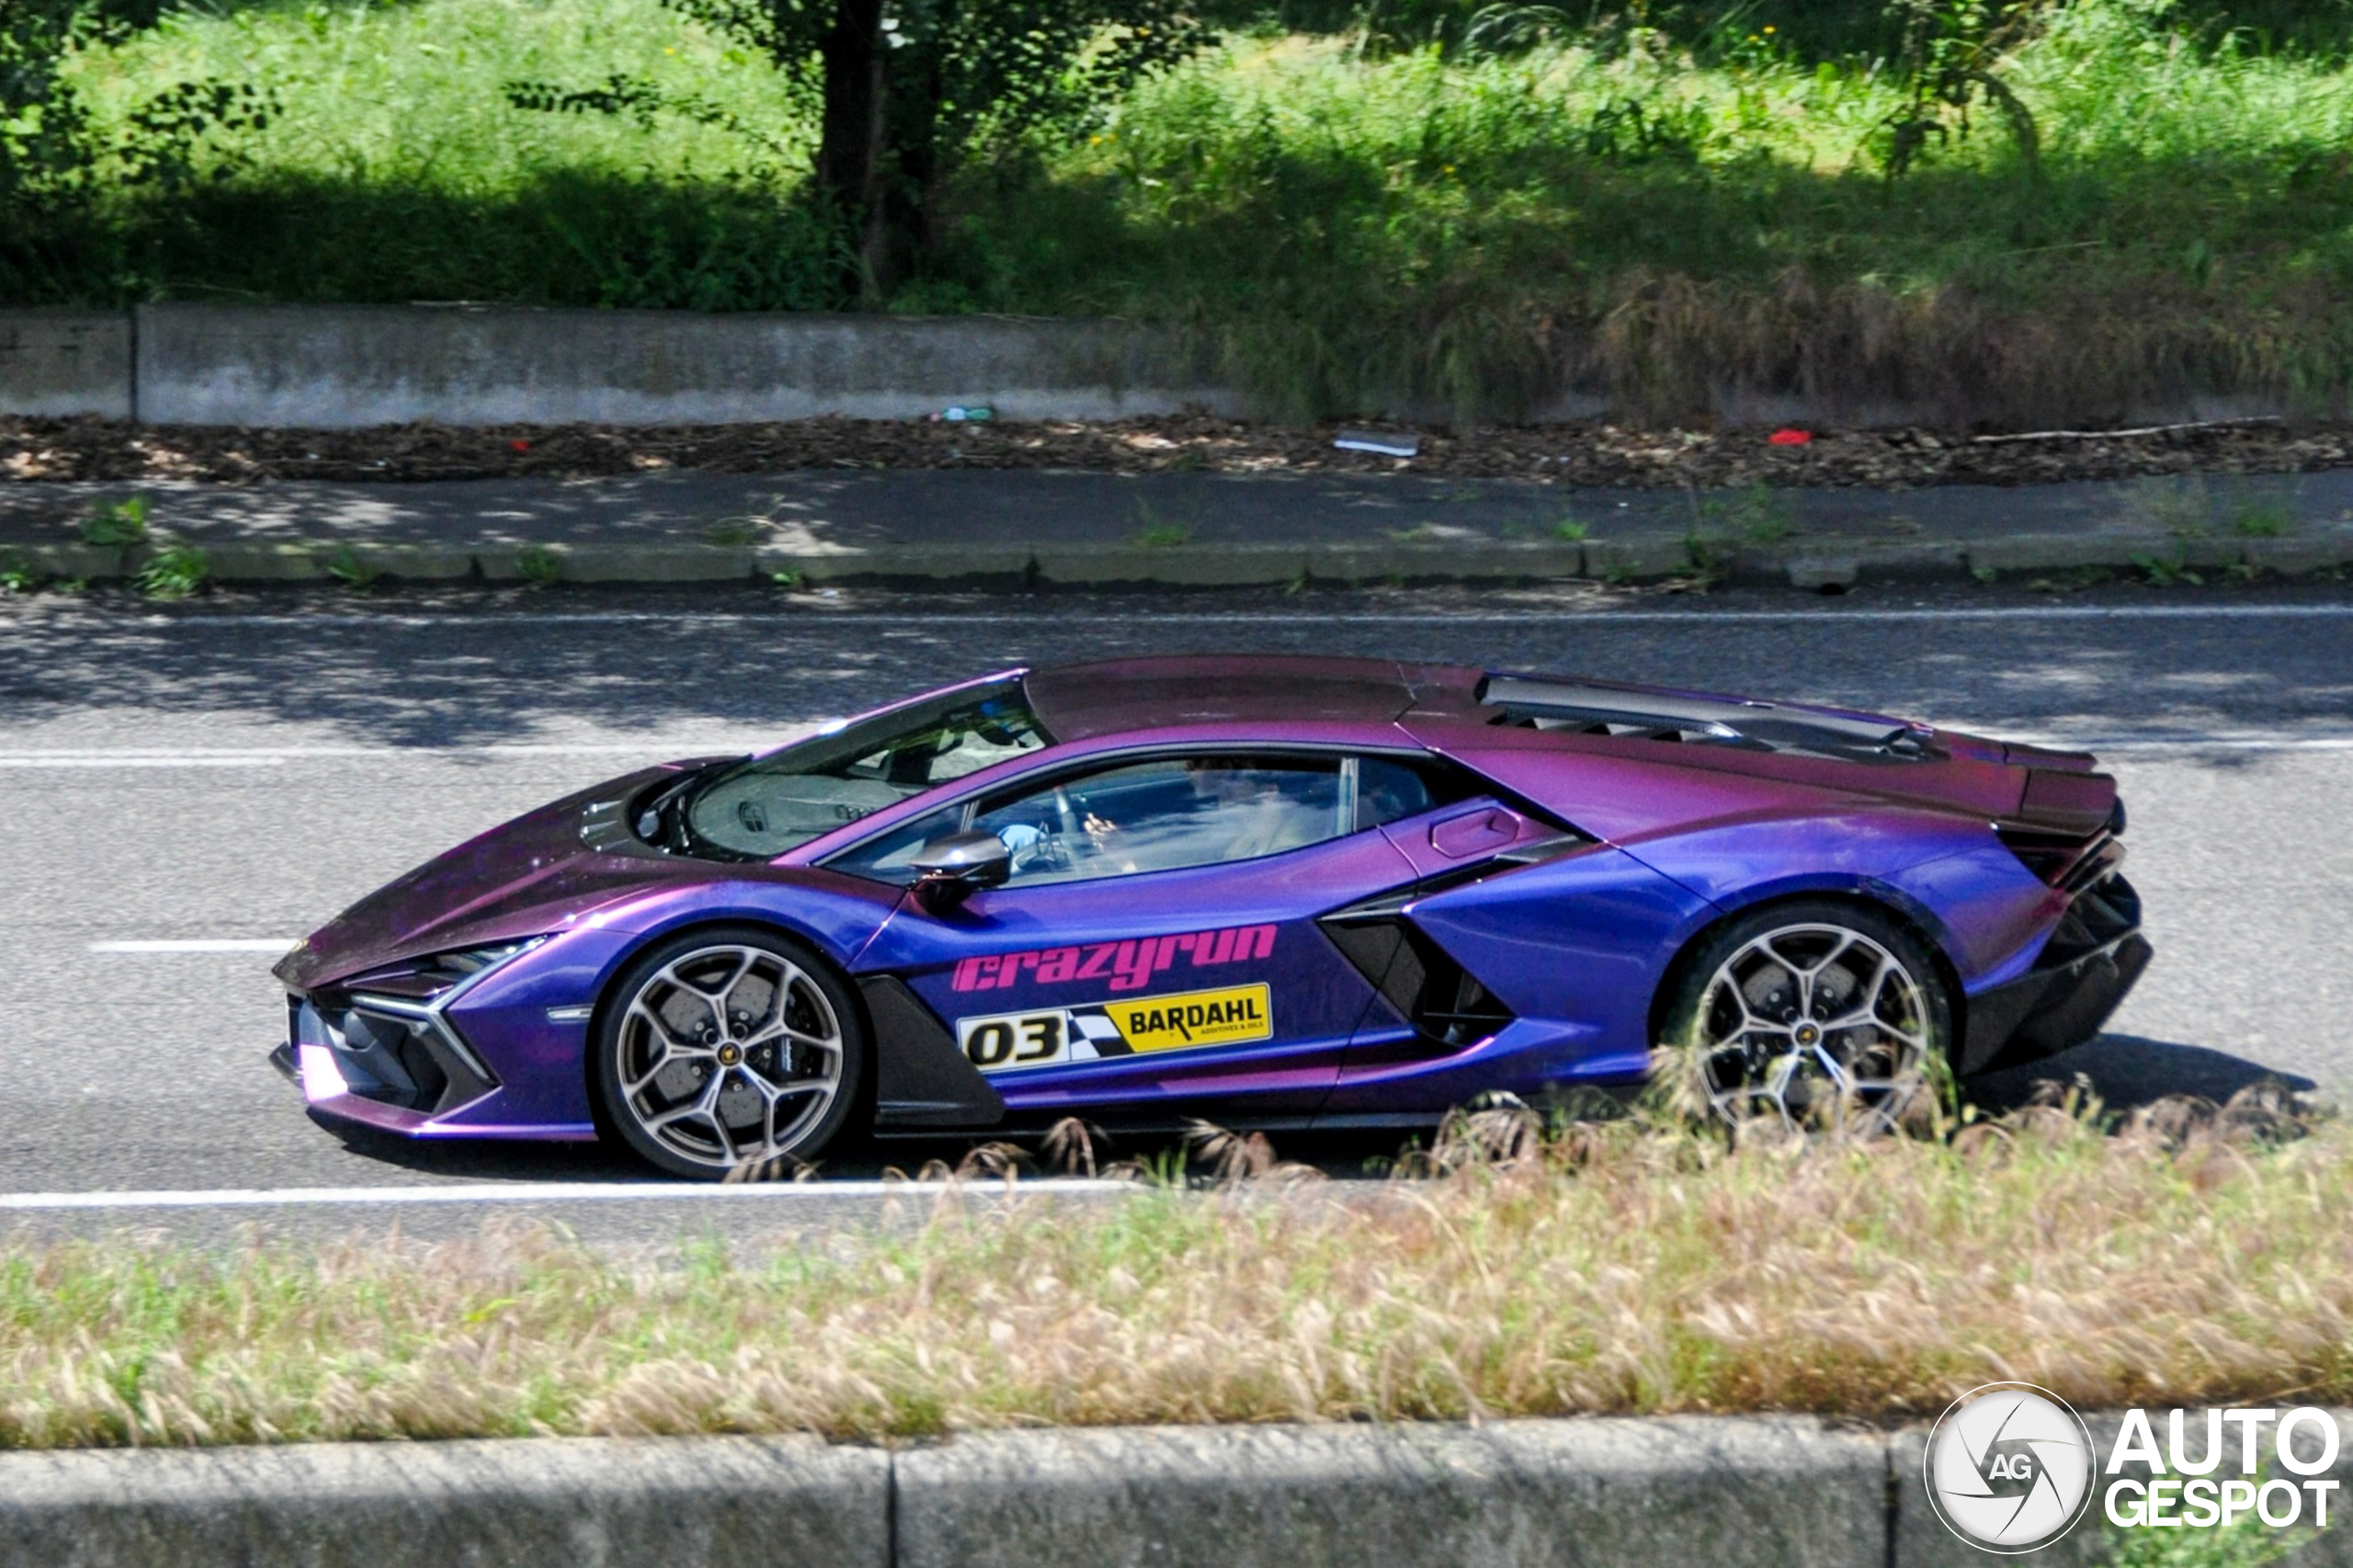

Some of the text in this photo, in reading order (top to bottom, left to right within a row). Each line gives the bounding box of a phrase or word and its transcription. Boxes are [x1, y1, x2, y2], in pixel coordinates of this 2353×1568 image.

[951, 924, 1278, 992] crazyrun
[967, 1016, 1062, 1066] 03
[1130, 998, 1262, 1041] BARDAHL
